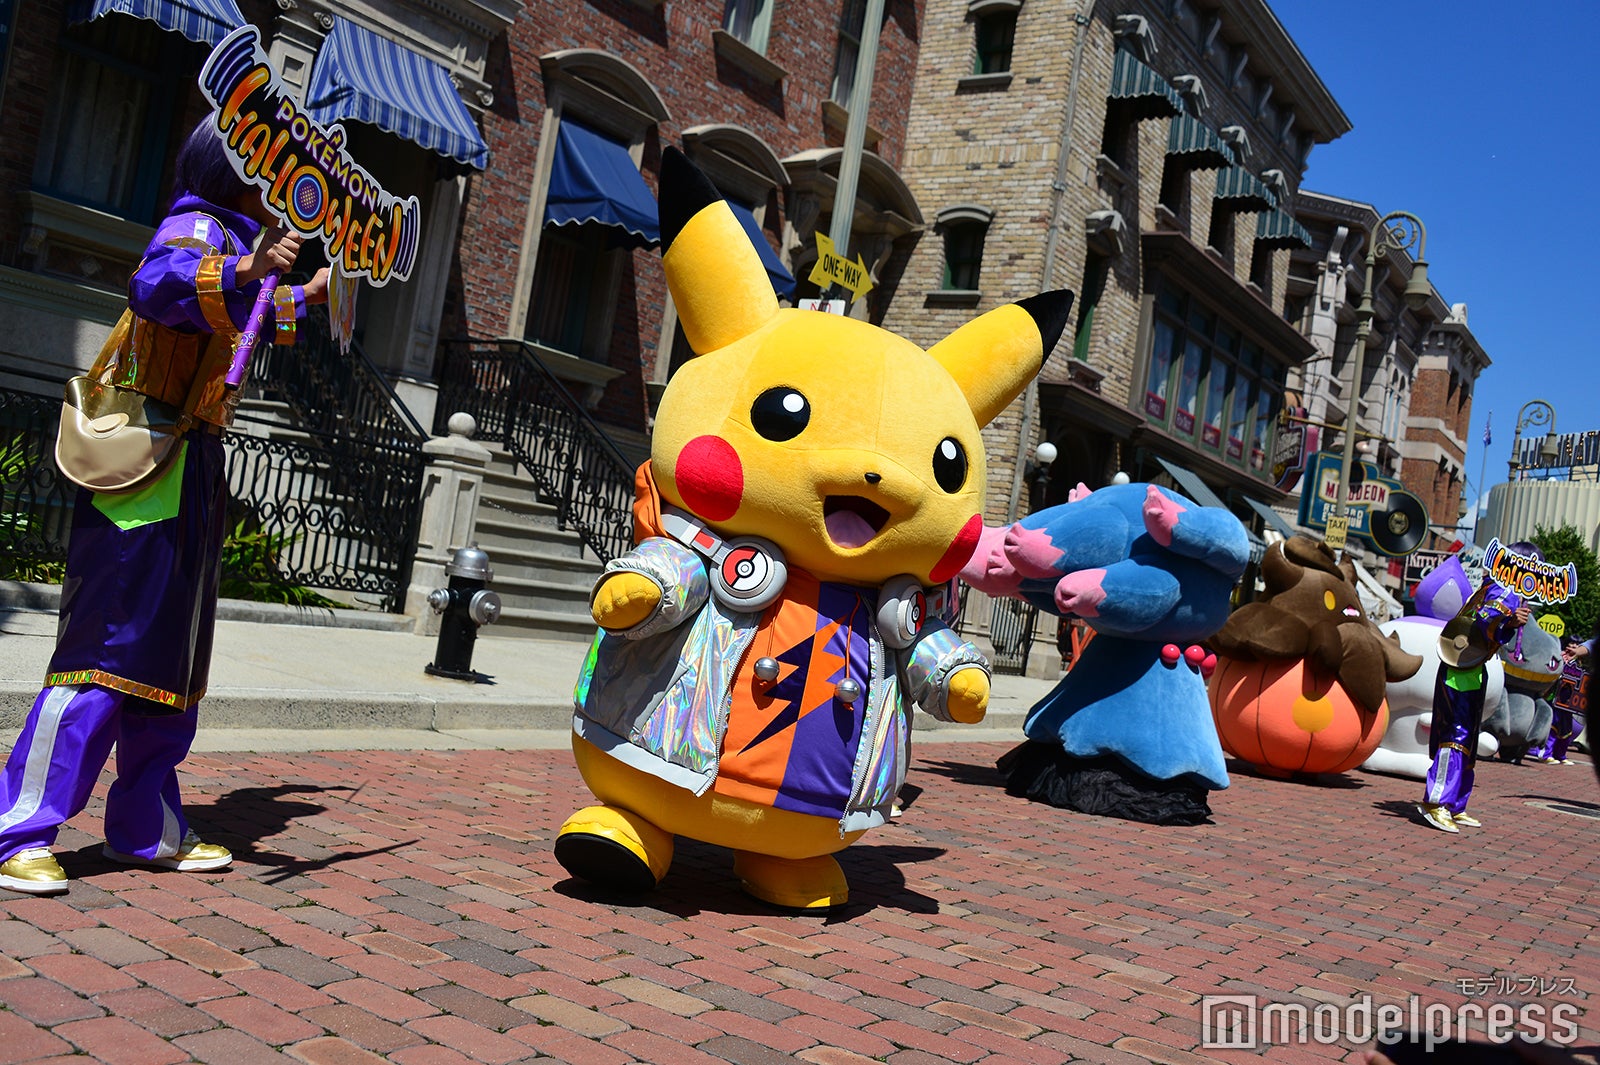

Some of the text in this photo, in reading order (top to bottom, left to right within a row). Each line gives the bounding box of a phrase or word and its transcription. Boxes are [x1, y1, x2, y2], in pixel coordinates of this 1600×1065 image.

[276, 100, 379, 212] POKÉMON
[219, 66, 402, 280] HALLOWEEN
[823, 253, 862, 289] ONE-WAY
[1325, 480, 1386, 504] MODEON
[1323, 503, 1364, 518] REORD
[1328, 519, 1347, 531] TAXI
[1326, 534, 1345, 545] ZONE
[1492, 548, 1570, 602] HALLOWEEN
[1510, 555, 1557, 577] POKÉMON
[1538, 621, 1563, 634] STOP
